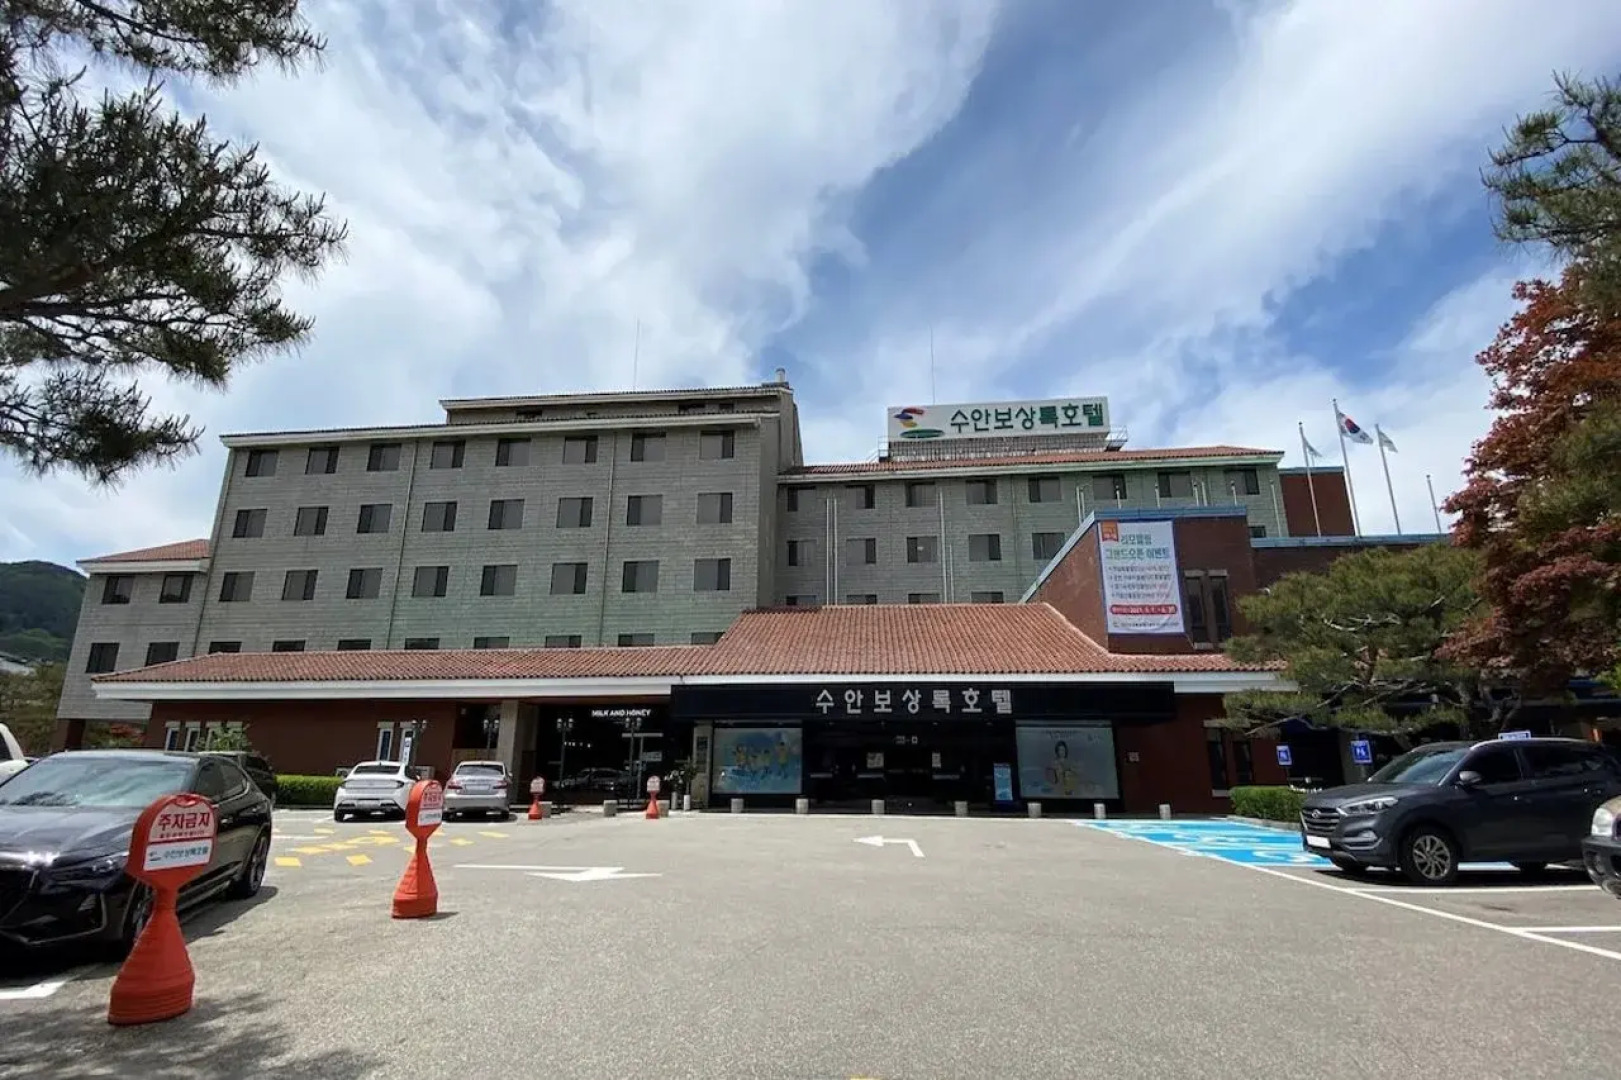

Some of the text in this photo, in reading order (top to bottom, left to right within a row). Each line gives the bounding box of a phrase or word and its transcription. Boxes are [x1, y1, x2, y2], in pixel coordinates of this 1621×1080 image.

[950, 402, 1104, 433] 수안보상록호텔
[609, 709, 625, 717] AND
[626, 708, 652, 716] HONEY
[815, 687, 1013, 714] 수안보상록호텔
